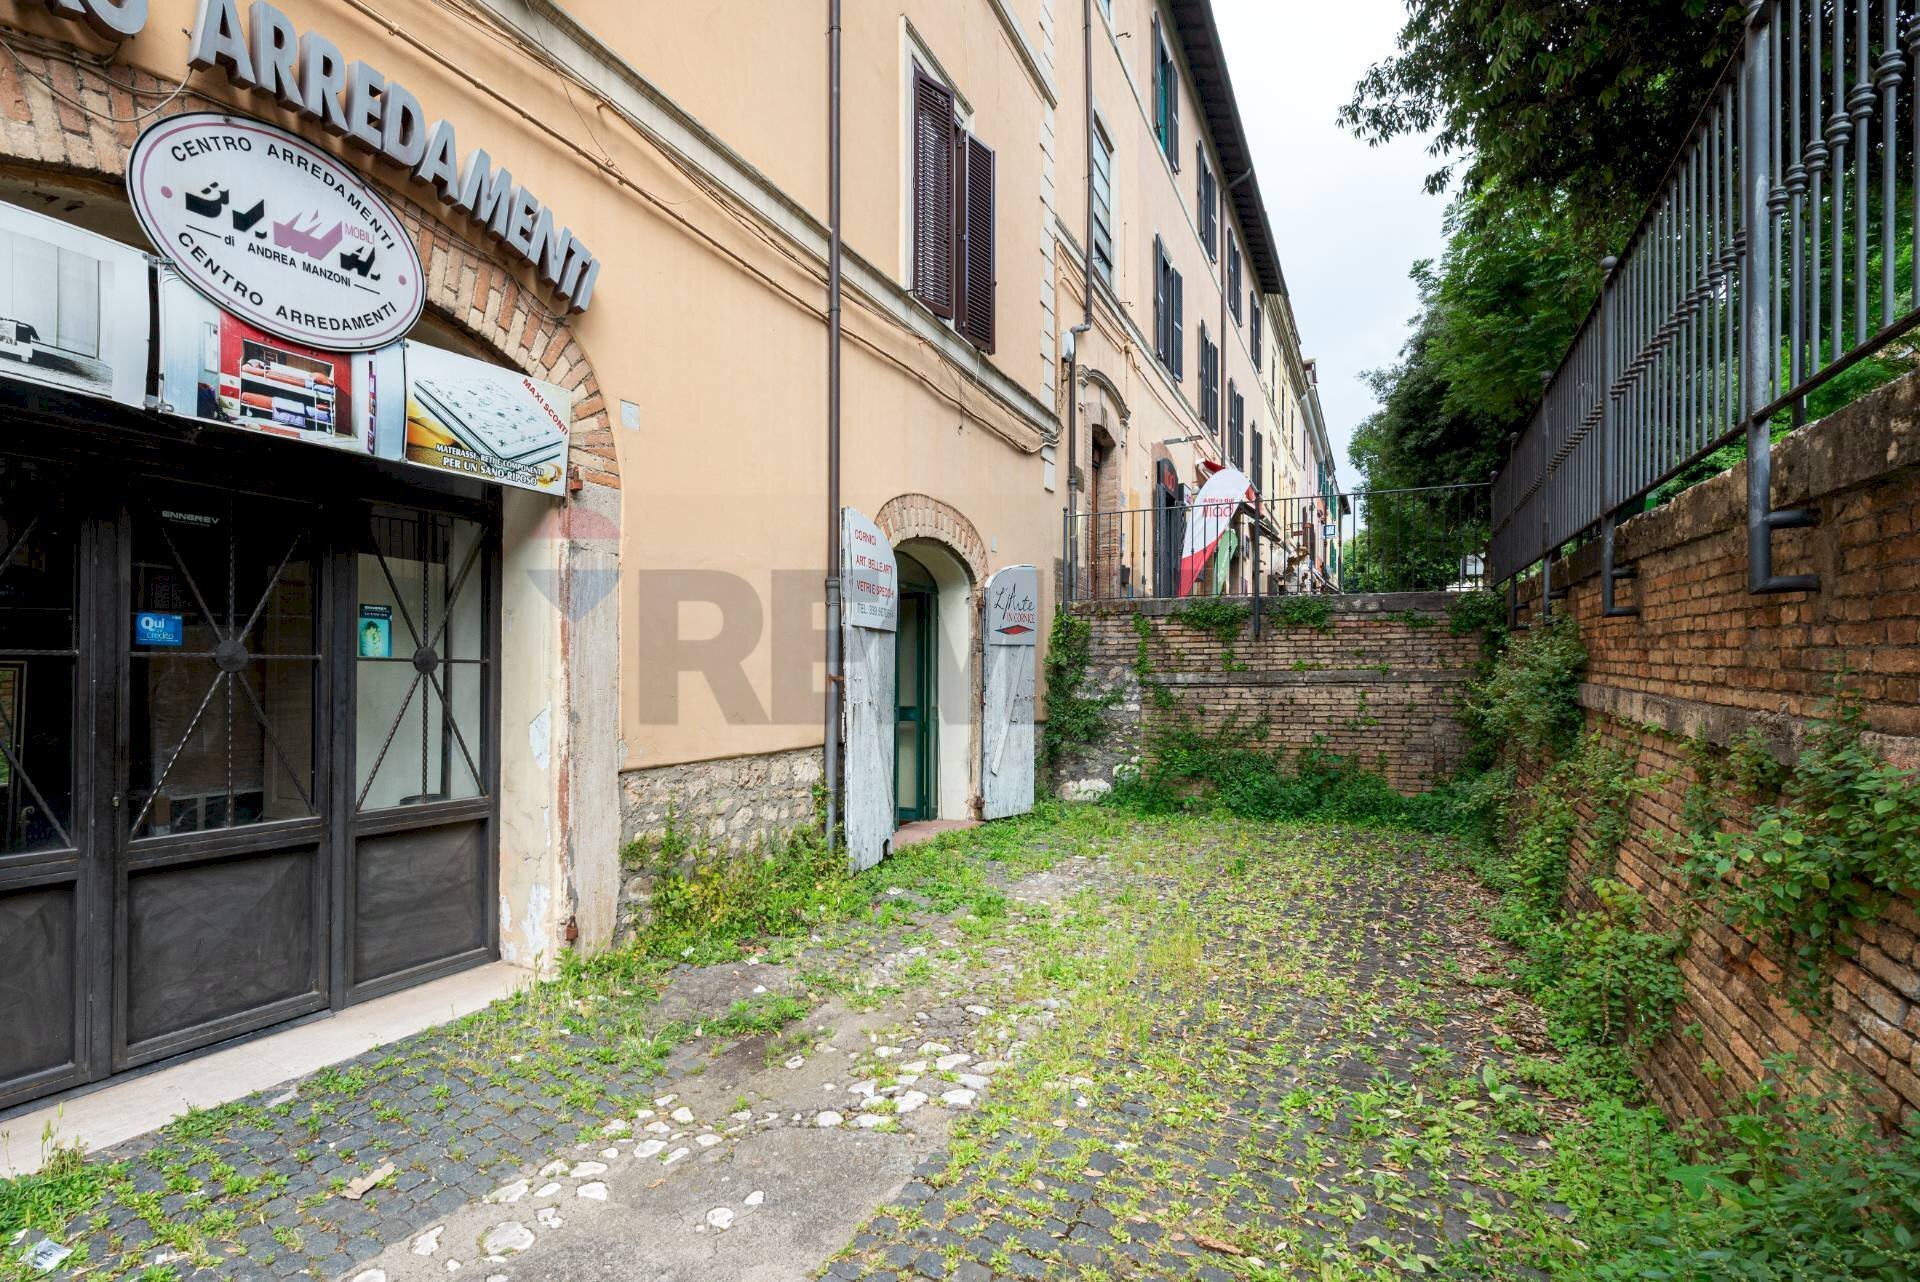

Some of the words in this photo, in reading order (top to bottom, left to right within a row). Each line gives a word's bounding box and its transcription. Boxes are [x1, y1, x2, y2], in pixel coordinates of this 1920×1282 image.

[187, 0, 600, 315] ARREDAMENTI
[171, 136, 253, 162] CENTRO
[267, 144, 395, 250] ARREDAMENTI
[344, 222, 375, 244] MOBILI
[224, 234, 235, 247] di
[247, 242, 297, 268] ANDREA
[302, 261, 351, 288] MANZONI
[178, 231, 263, 306] CENTRO
[275, 301, 397, 331] ARREDAMENTI
[523, 378, 544, 405] MAXI
[544, 403, 568, 435] SCONTI
[443, 456, 461, 469] PER
[464, 460, 478, 473] UN
[480, 464, 505, 479] SANO
[506, 471, 538, 486] RIPOSO
[503, 459, 545, 477] COMPONENTI
[854, 529, 876, 546] CORNICI
[868, 558, 883, 572] BELLE
[141, 616, 165, 631] Qui
